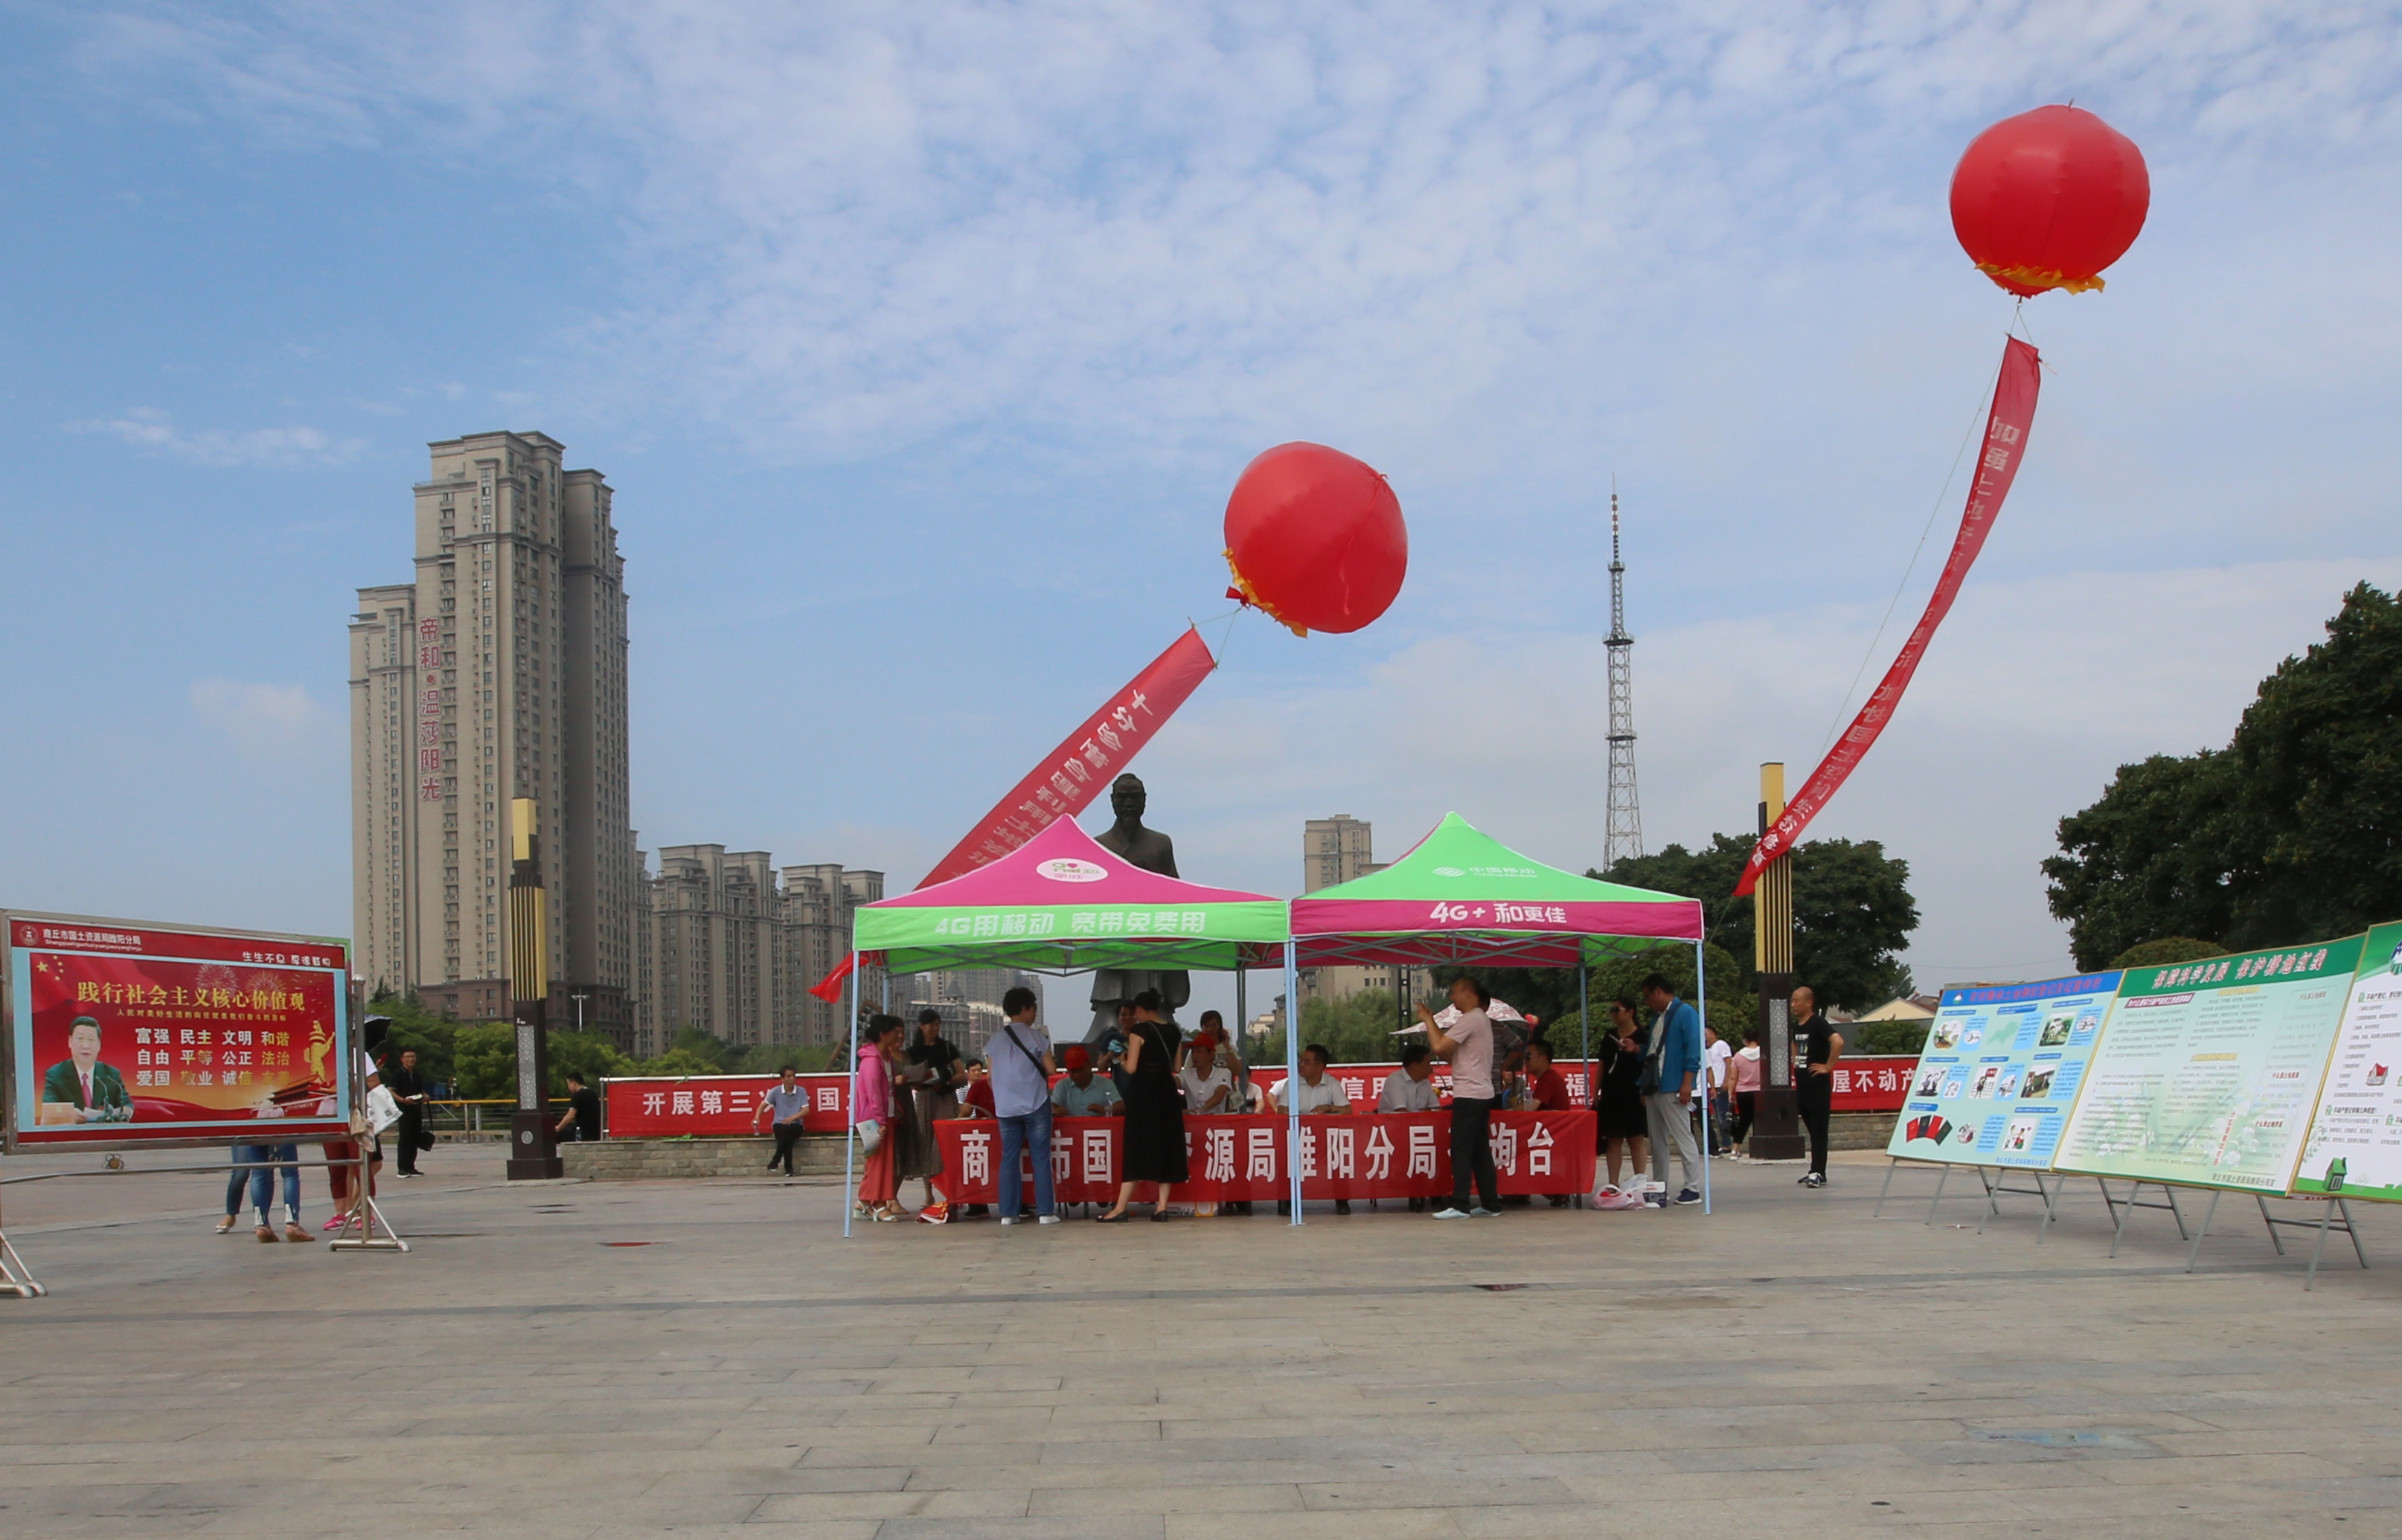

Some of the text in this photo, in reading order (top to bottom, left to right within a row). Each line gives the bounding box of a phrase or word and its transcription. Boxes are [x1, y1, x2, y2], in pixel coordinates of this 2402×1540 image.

[1469, 866, 1535, 874] 中国移动
[1493, 902, 1567, 923] 和更佳
[934, 911, 1206, 937] 4G用移动 宽带免费用
[77, 981, 305, 1011] 践行社会主义核心价值观
[135, 1027, 289, 1047] 富强 民主 文明 和谐
[138, 1049, 289, 1066] 自由 平等 公正 法治
[137, 1070, 170, 1086] 爱国
[180, 1071, 213, 1086] 敬业
[222, 1071, 253, 1086] 诚信
[642, 1087, 840, 1115] 开展第三国
[961, 1121, 1554, 1186] 商市国源局睢阳分局询台
